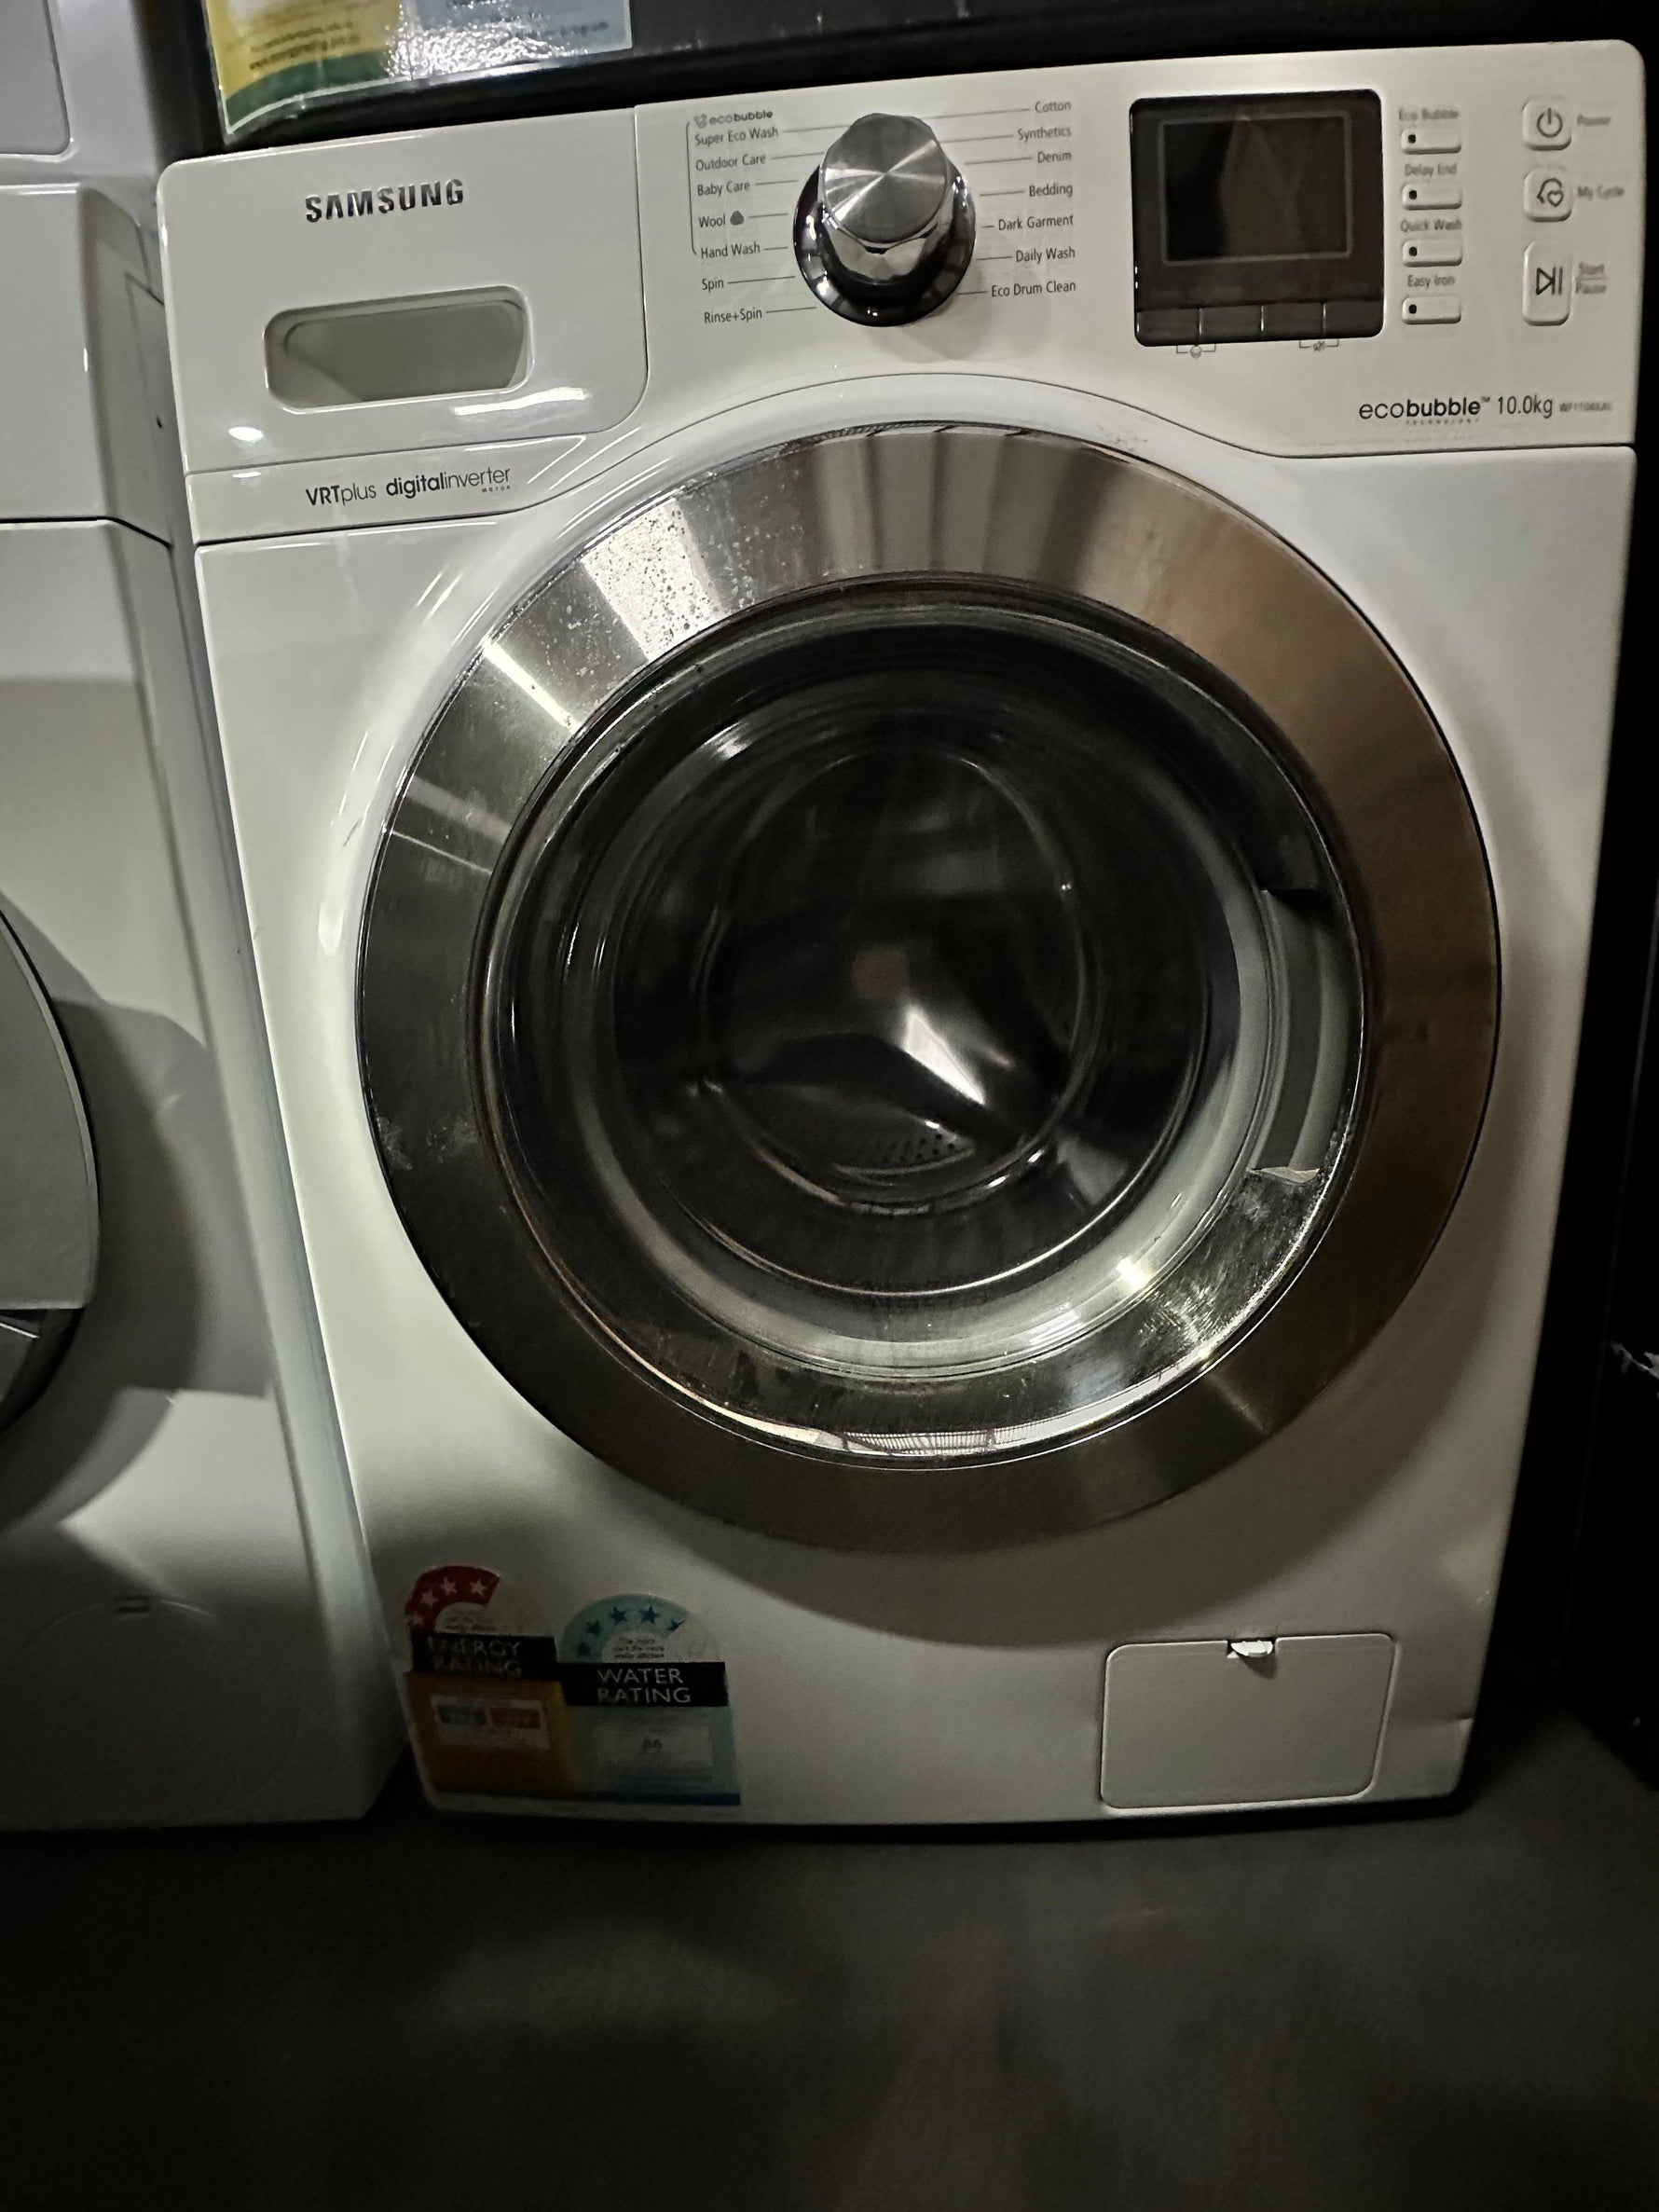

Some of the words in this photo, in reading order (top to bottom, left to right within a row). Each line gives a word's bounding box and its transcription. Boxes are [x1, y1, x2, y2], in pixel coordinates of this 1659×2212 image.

[1035, 101, 1071, 113] Cotton
[708, 109, 774, 125] ecobubble
[694, 133, 724, 146] Super
[728, 130, 747, 142] Eco
[749, 126, 778, 140] Wash
[1018, 126, 1072, 143] Synthetics
[695, 158, 738, 172] Outdoor
[742, 154, 767, 166] Care
[1037, 151, 1072, 163] Denim
[697, 183, 723, 197] Baby
[726, 180, 750, 193] Care
[1029, 184, 1073, 198] Bedding
[305, 179, 464, 223] SAMSUNG
[699, 213, 726, 227] Wool
[998, 217, 1023, 231] Dark
[1027, 214, 1074, 228] Garment
[701, 245, 728, 259] Hand
[731, 241, 761, 255] Wash
[1016, 249, 1042, 264] Daily
[1046, 246, 1076, 260] Wash
[702, 278, 724, 292] Spin
[992, 284, 1010, 297] Eco
[1013, 282, 1043, 296] Drum
[1046, 279, 1076, 294] Clean
[1407, 275, 1431, 289] Easy
[704, 308, 762, 324] Rinse+Spin
[1497, 394, 1554, 419] 10.0kg
[306, 483, 377, 506] VRTplus
[385, 466, 512, 500] digitalinverter
[596, 1667, 685, 1685] WATER
[596, 1687, 692, 1705] RATING
